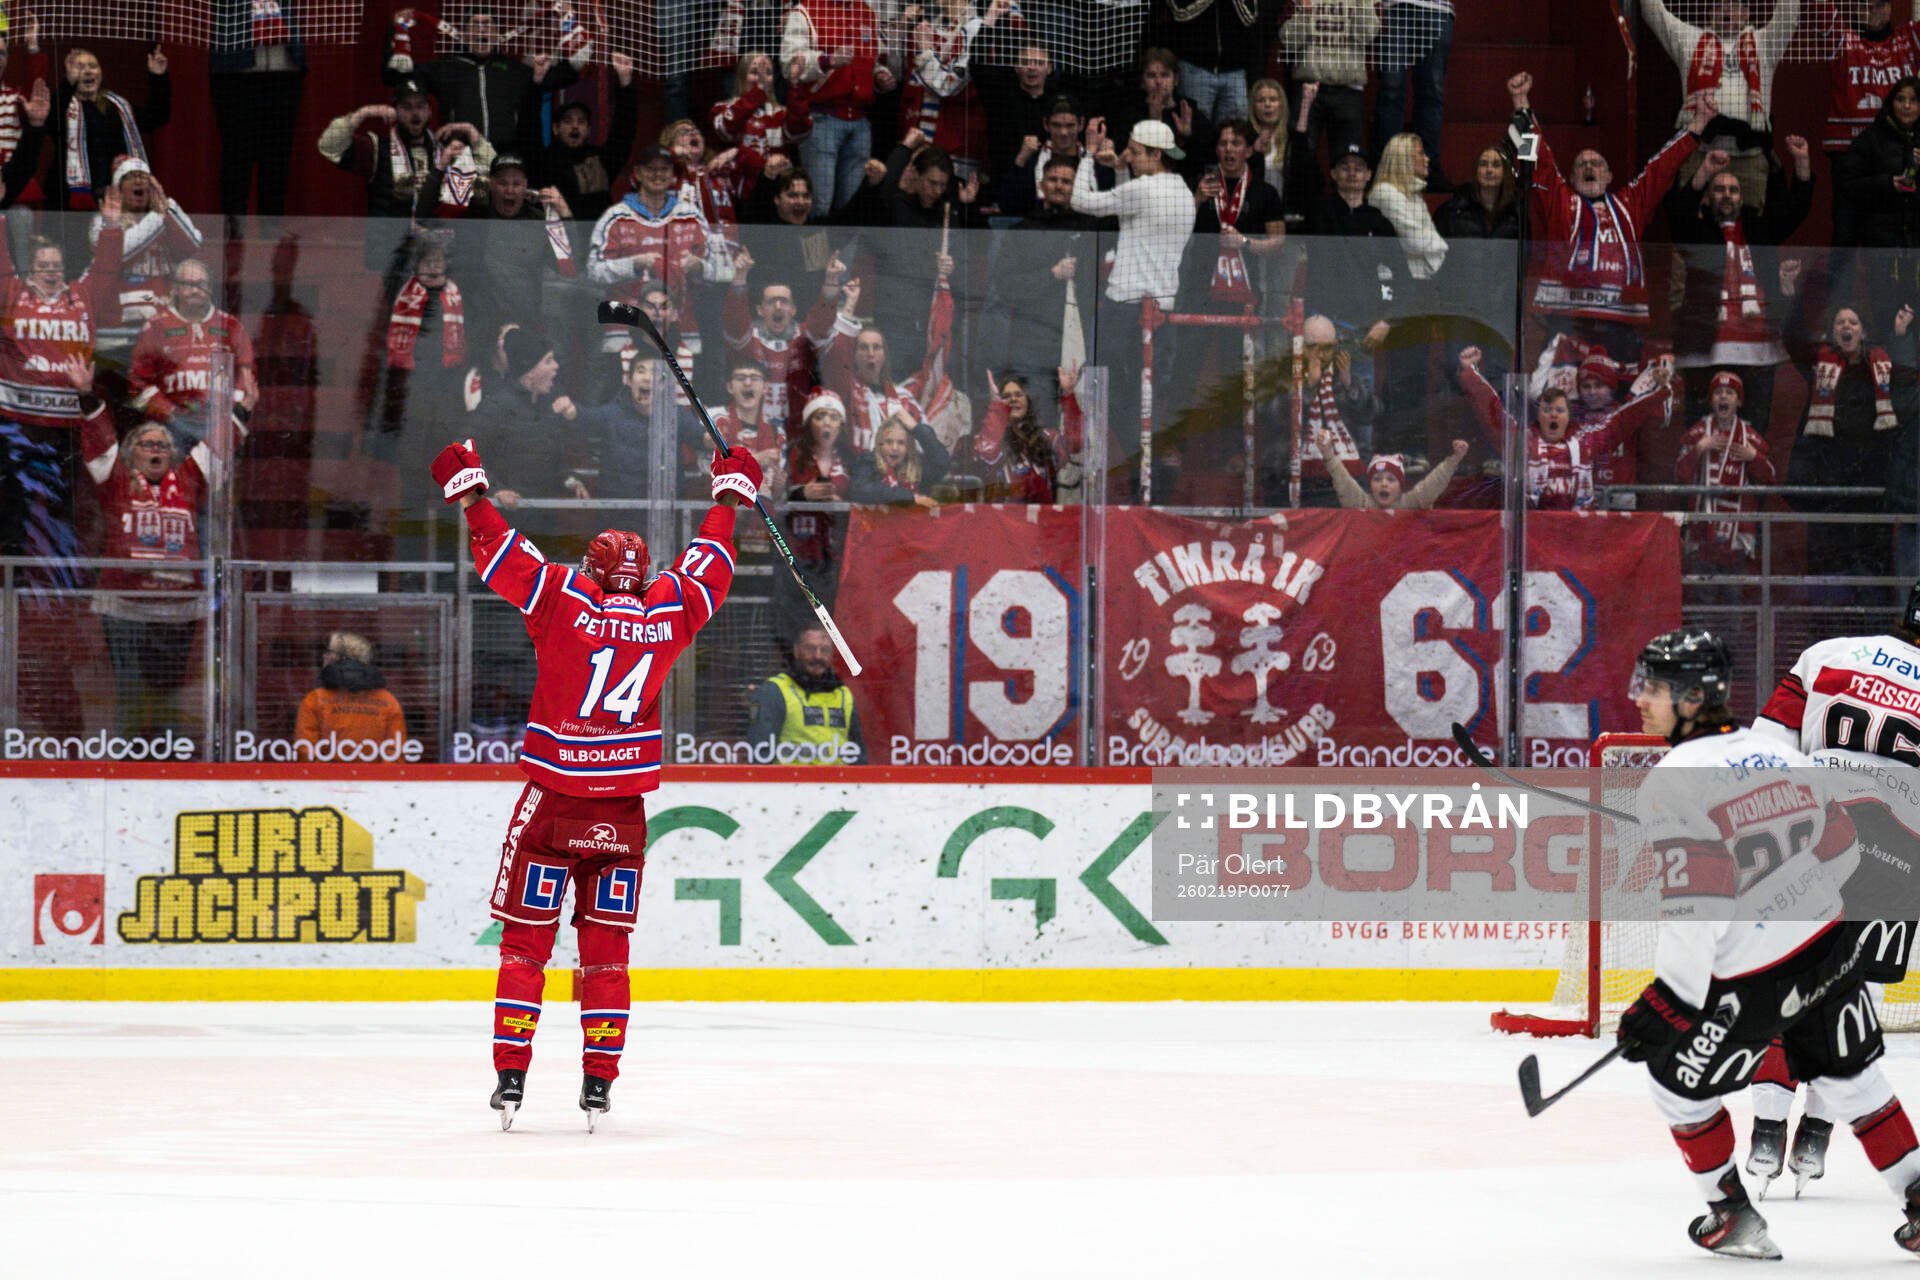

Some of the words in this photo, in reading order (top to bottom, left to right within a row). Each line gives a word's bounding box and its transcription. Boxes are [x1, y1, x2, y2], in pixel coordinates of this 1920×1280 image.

[1133, 531, 1266, 606] TIMRÅ
[573, 610, 673, 643] PETTERSON
[892, 568, 1069, 741] 19
[1302, 632, 1338, 671] 62
[577, 645, 655, 724] 14
[1119, 637, 1150, 680] 19
[1849, 674, 1920, 714] PERSSO
[559, 746, 641, 762] BILBOLAGET
[175, 806, 345, 876] EURO
[568, 838, 630, 853] PROLYMPIA
[937, 805, 1171, 947] GK
[117, 871, 405, 943] JACKPOT
[1331, 922, 1389, 940] BYGG
[1676, 1020, 1729, 1089] akea
